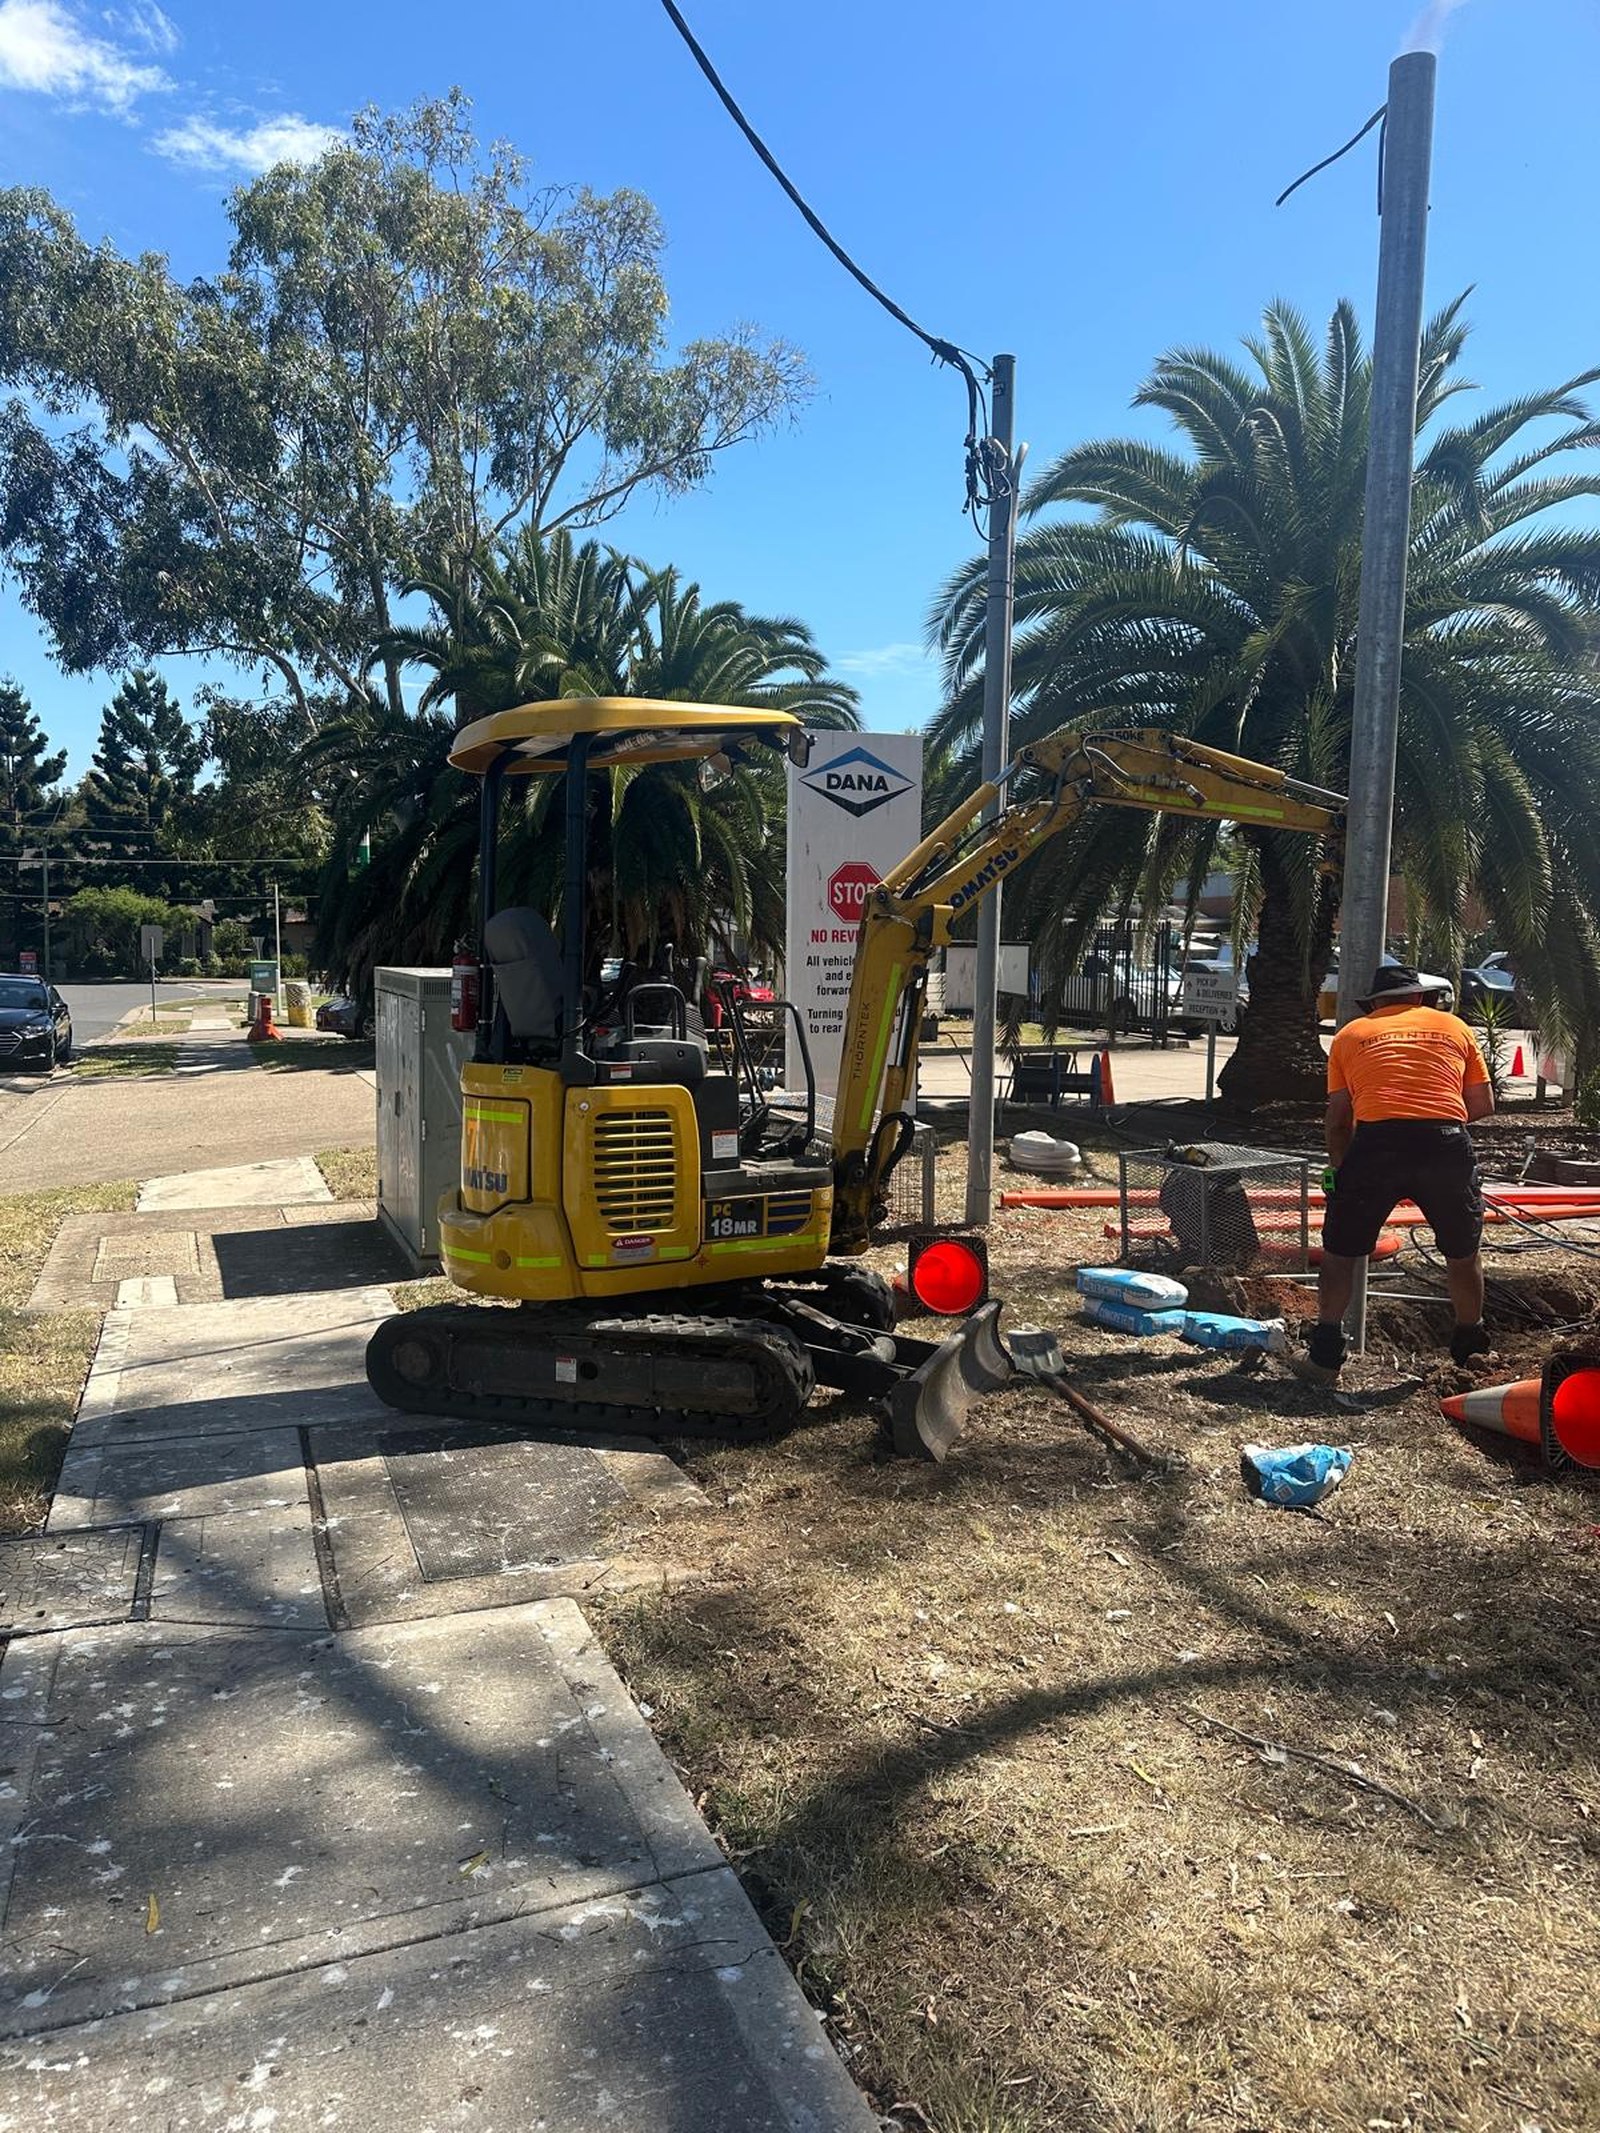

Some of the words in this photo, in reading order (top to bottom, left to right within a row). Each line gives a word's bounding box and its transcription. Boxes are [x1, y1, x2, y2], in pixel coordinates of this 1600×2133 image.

[826, 773, 889, 792] DANA
[950, 849, 1019, 908] OMATSU
[811, 929, 828, 943] NO
[806, 955, 820, 967] All
[823, 955, 855, 967] vehicl
[825, 970, 843, 981] and
[816, 985, 851, 996] forwar
[808, 1008, 844, 1021] Turning
[1188, 1003, 1218, 1015] RECEPTION
[810, 1023, 819, 1034] to
[822, 1024, 842, 1034] rear
[712, 1202, 732, 1217] PC
[711, 1218, 757, 1237] 18MR
